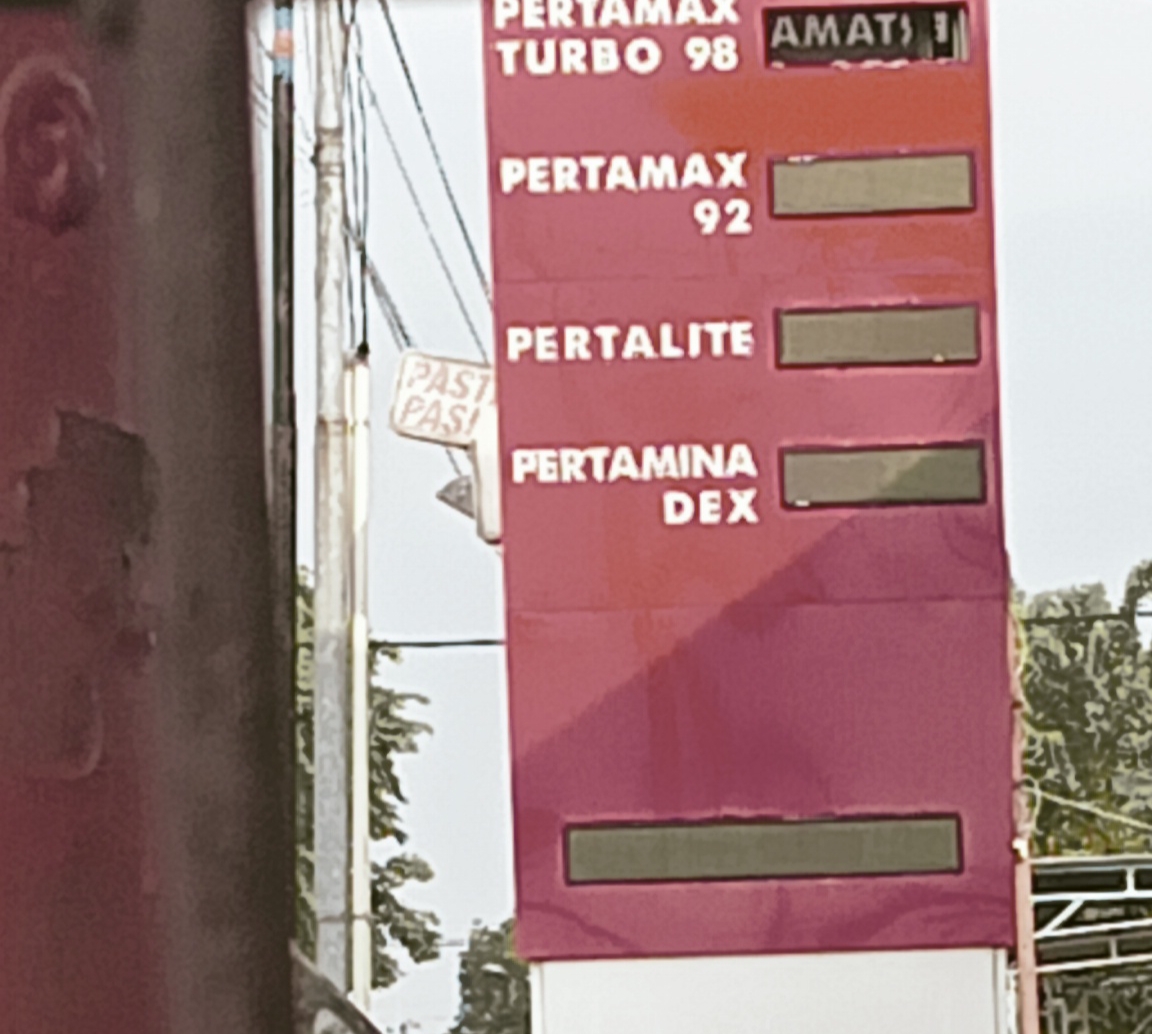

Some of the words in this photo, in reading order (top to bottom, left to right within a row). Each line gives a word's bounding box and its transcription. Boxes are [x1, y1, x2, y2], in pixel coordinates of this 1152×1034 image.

[494, 0, 740, 30] PERTAMAX
[495, 36, 662, 75] TURBO
[684, 34, 739, 72] 98
[500, 152, 748, 192] PERTAMAX
[693, 200, 752, 235] 92
[507, 321, 755, 362] PERTALITE
[511, 443, 758, 483] PERTAMINA
[663, 489, 761, 525] DEX
